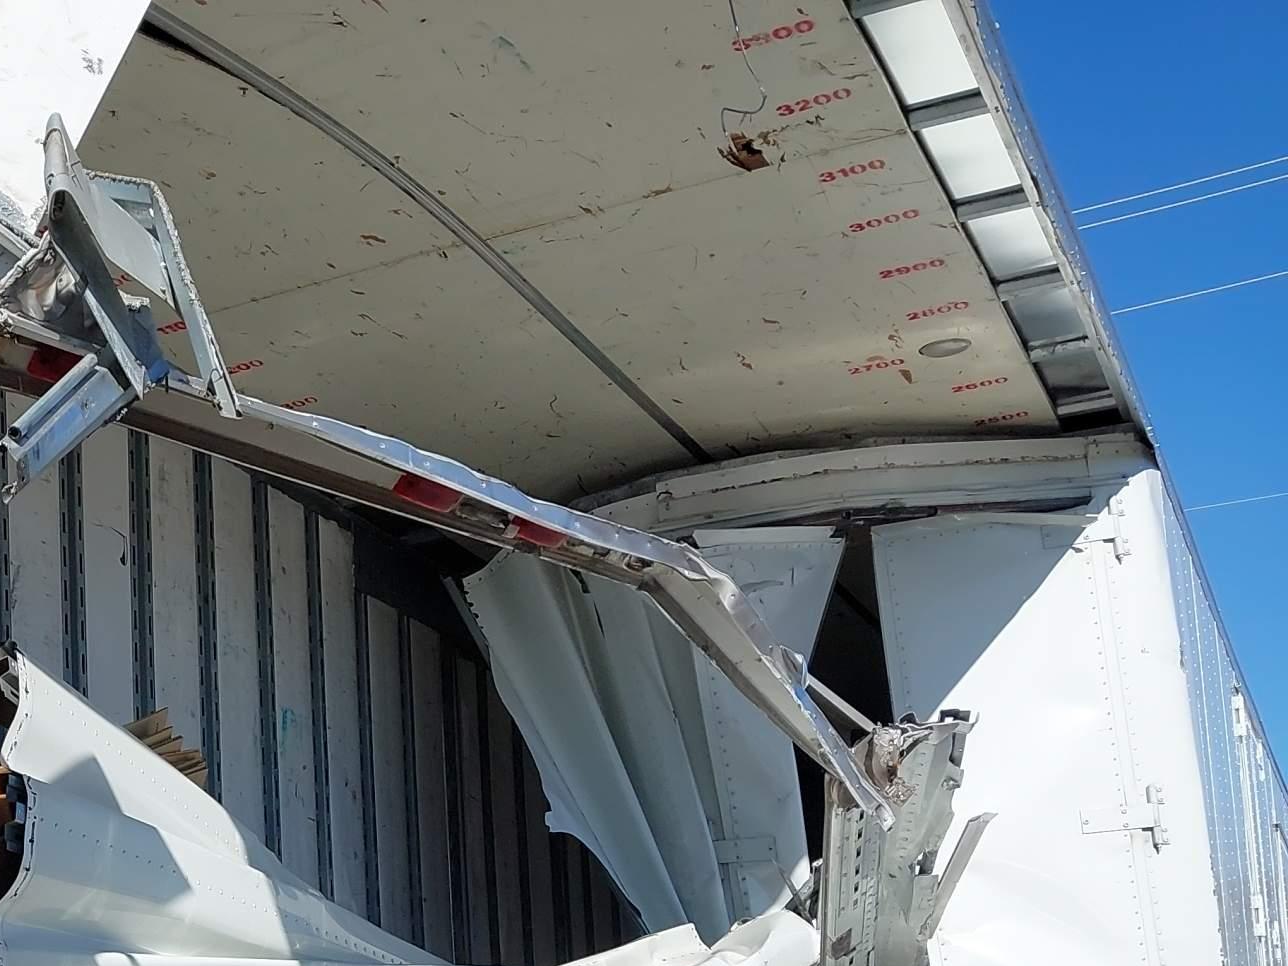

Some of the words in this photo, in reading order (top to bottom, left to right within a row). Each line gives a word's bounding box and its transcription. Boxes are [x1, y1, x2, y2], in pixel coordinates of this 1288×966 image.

[777, 89, 853, 119] 3200
[819, 158, 886, 184] 3100
[849, 209, 920, 233] 3000
[878, 258, 945, 280] 2900
[906, 301, 970, 321] 2800
[848, 358, 905, 376] 2700
[951, 376, 1010, 394] 2600
